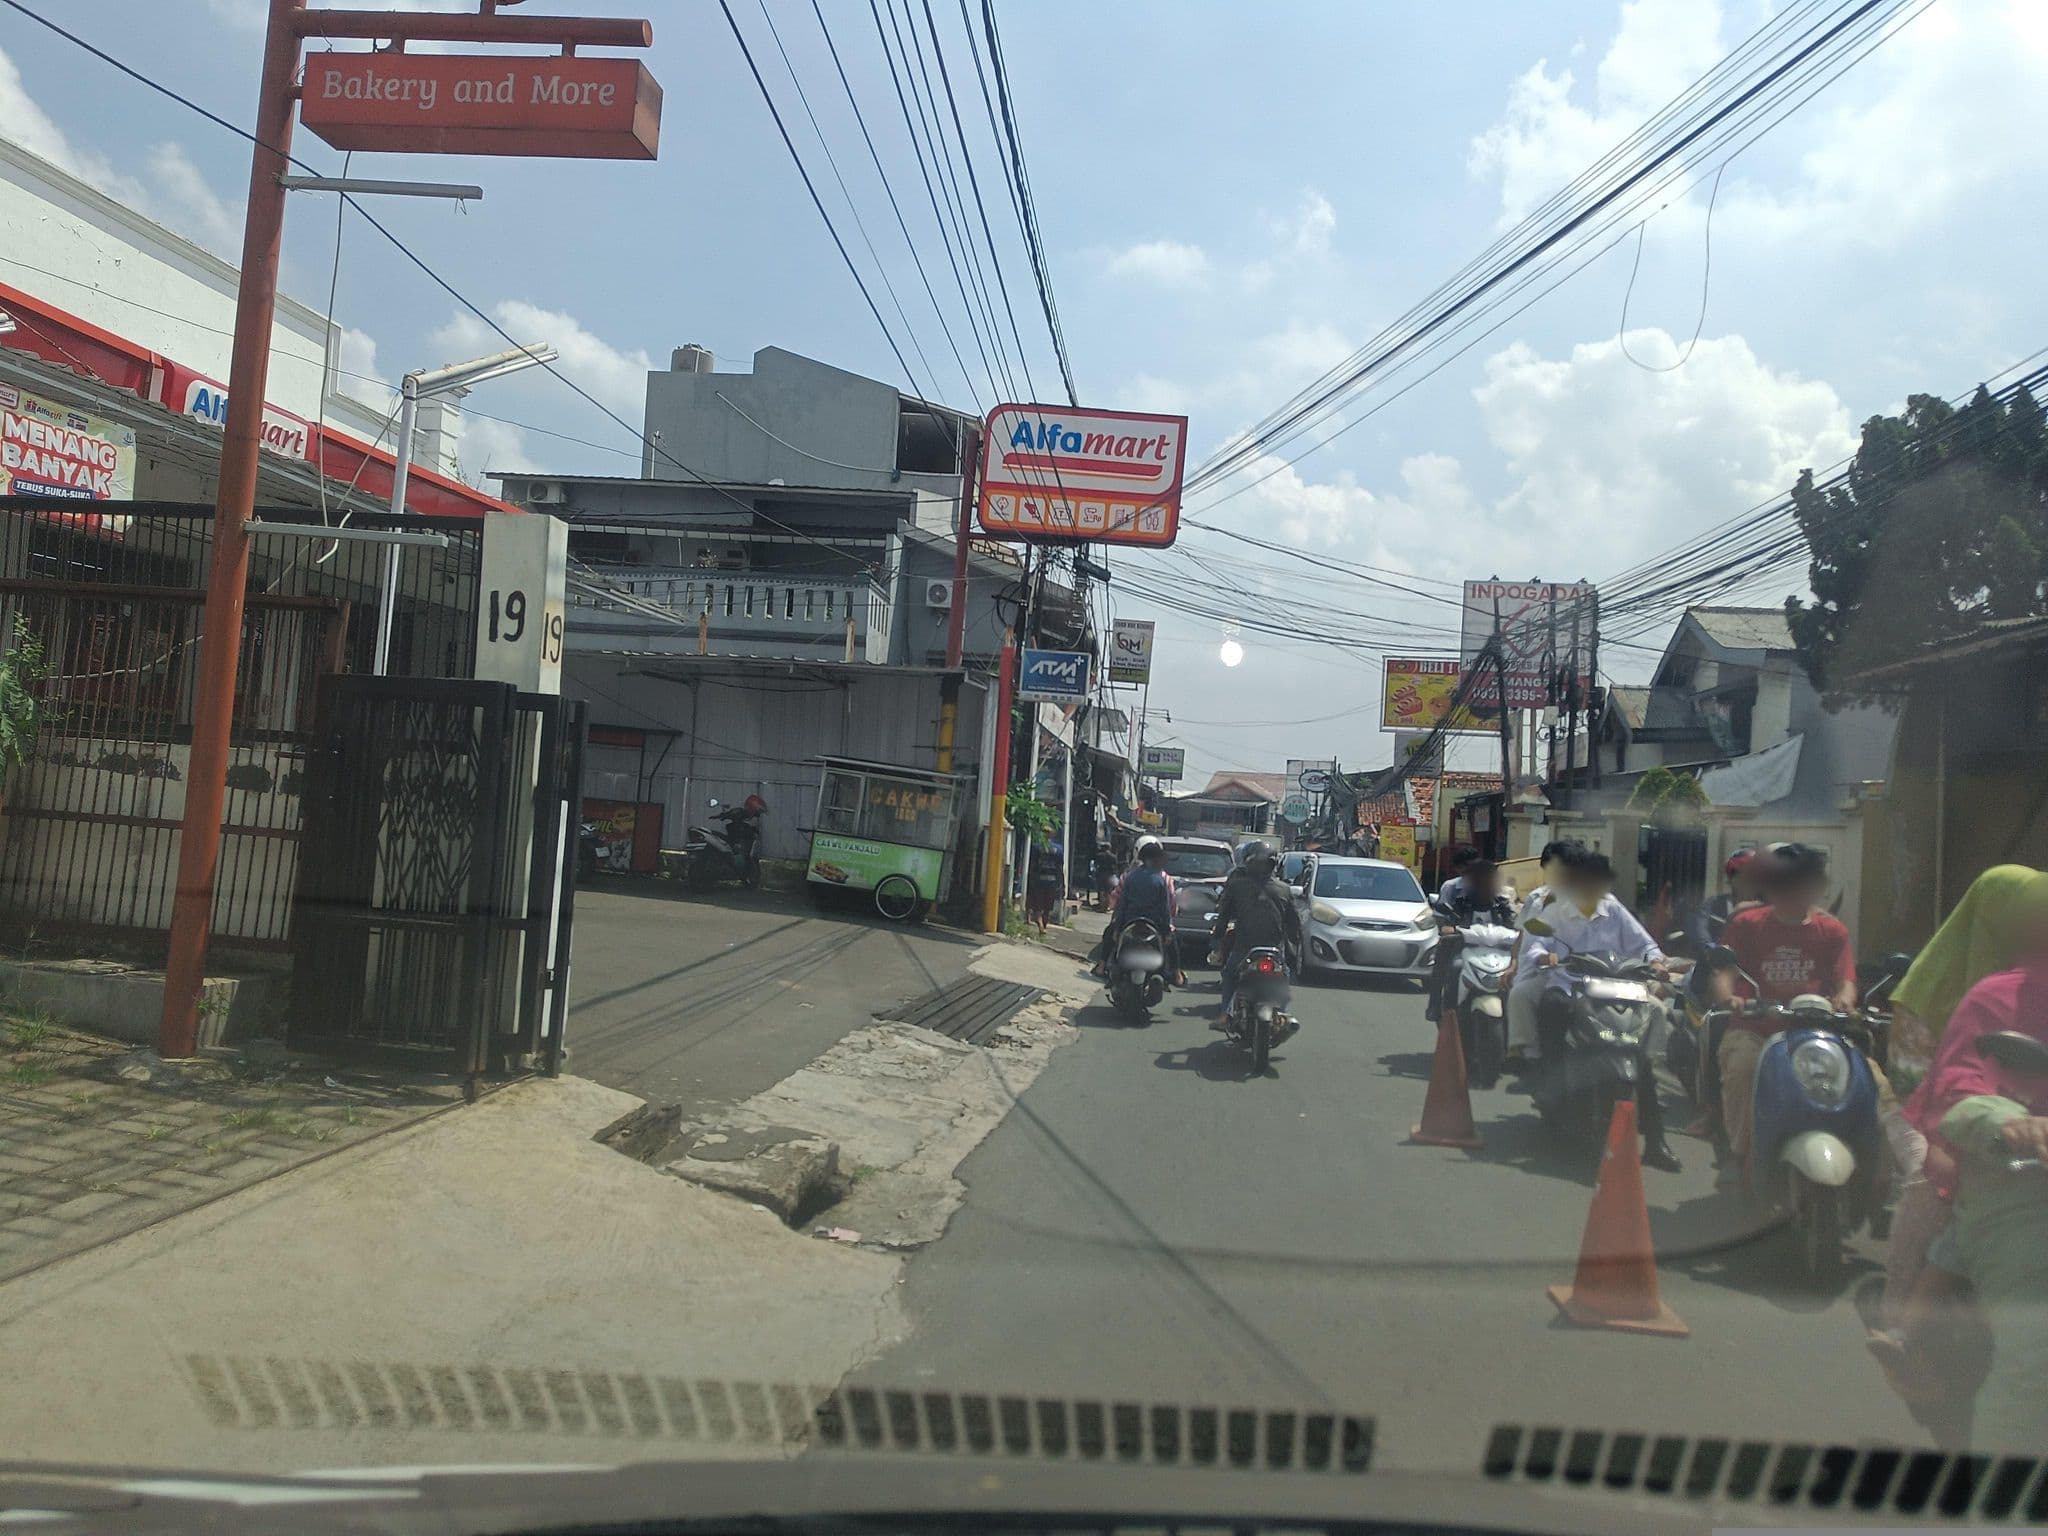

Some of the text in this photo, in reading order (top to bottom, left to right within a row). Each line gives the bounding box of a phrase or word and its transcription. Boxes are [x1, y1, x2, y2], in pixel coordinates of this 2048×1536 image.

[322, 70, 616, 110] Bakery and More
[4, 412, 116, 470] MENANG
[1010, 420, 1170, 461] Alfamart
[2, 443, 112, 498] BANYAK
[16, 480, 44, 494] TEBUS
[488, 590, 526, 643] 19
[542, 612, 562, 664] 19
